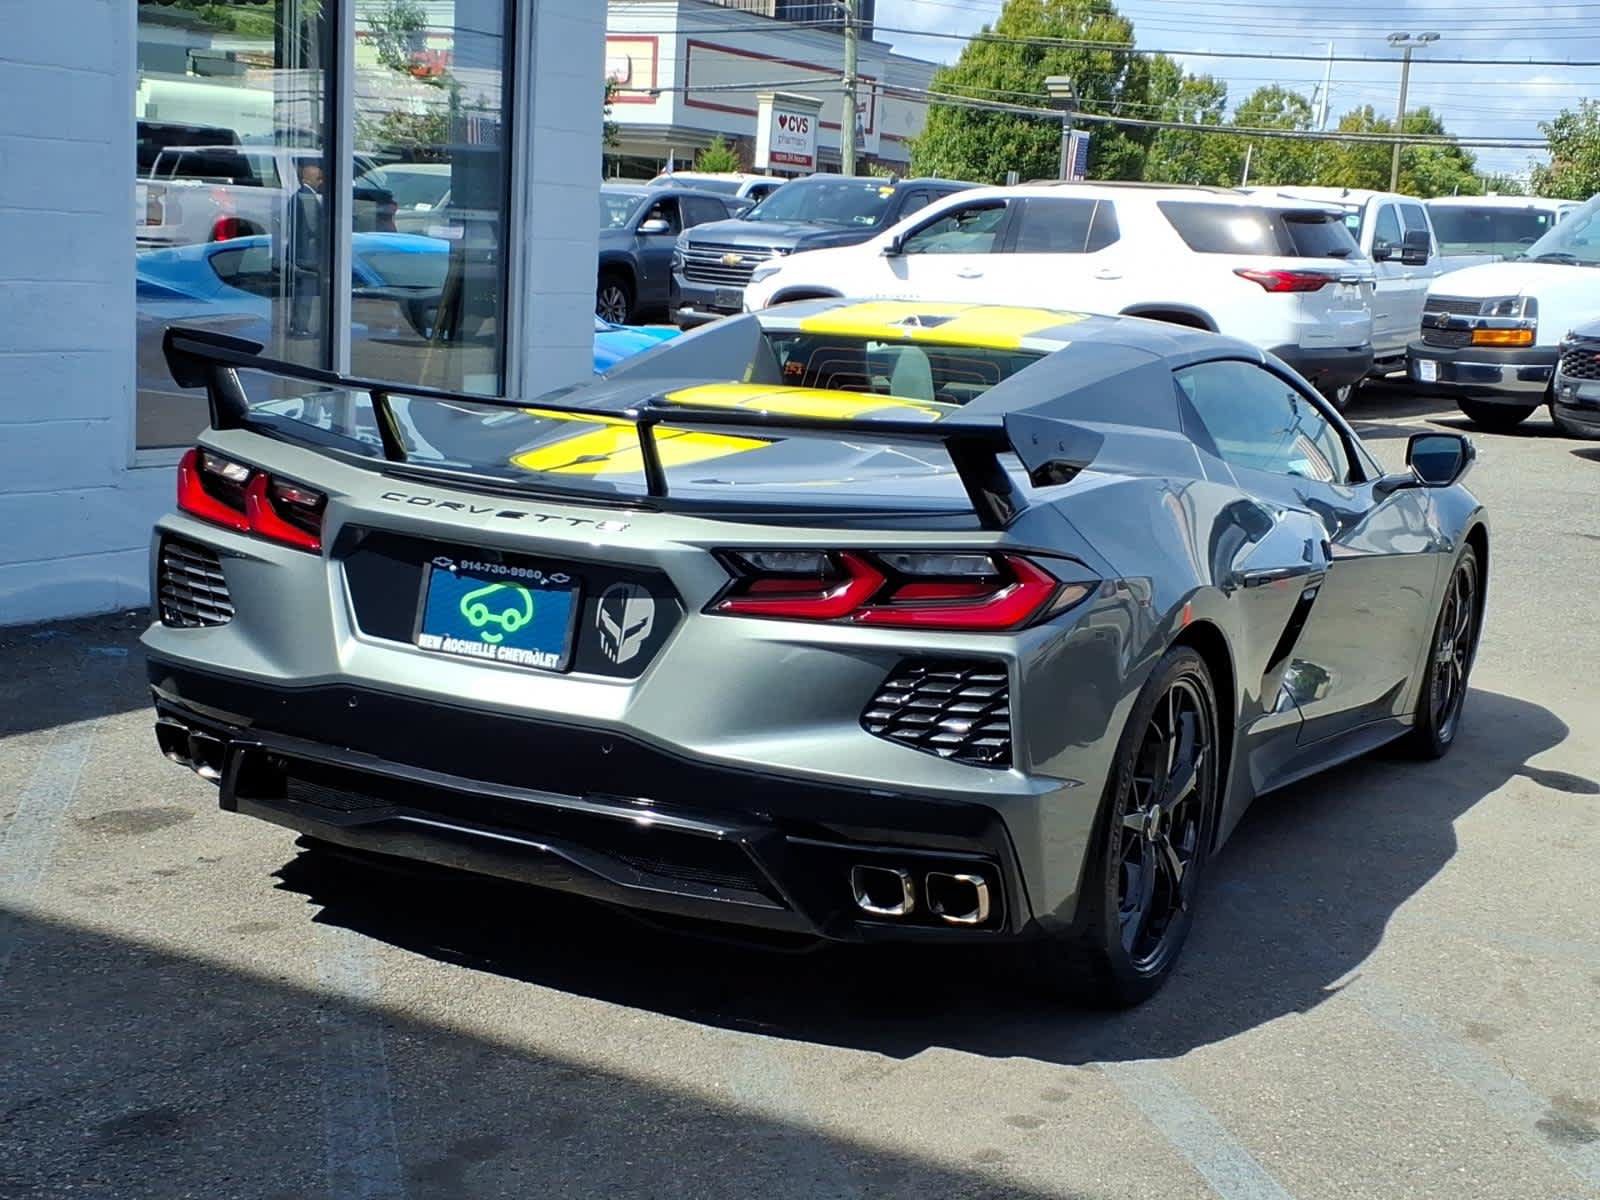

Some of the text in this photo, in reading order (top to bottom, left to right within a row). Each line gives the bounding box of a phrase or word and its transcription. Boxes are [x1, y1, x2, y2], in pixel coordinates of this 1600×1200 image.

[789, 116, 808, 134] CVS
[418, 633, 560, 668] NEW ROCHELLE CHEVROLET
